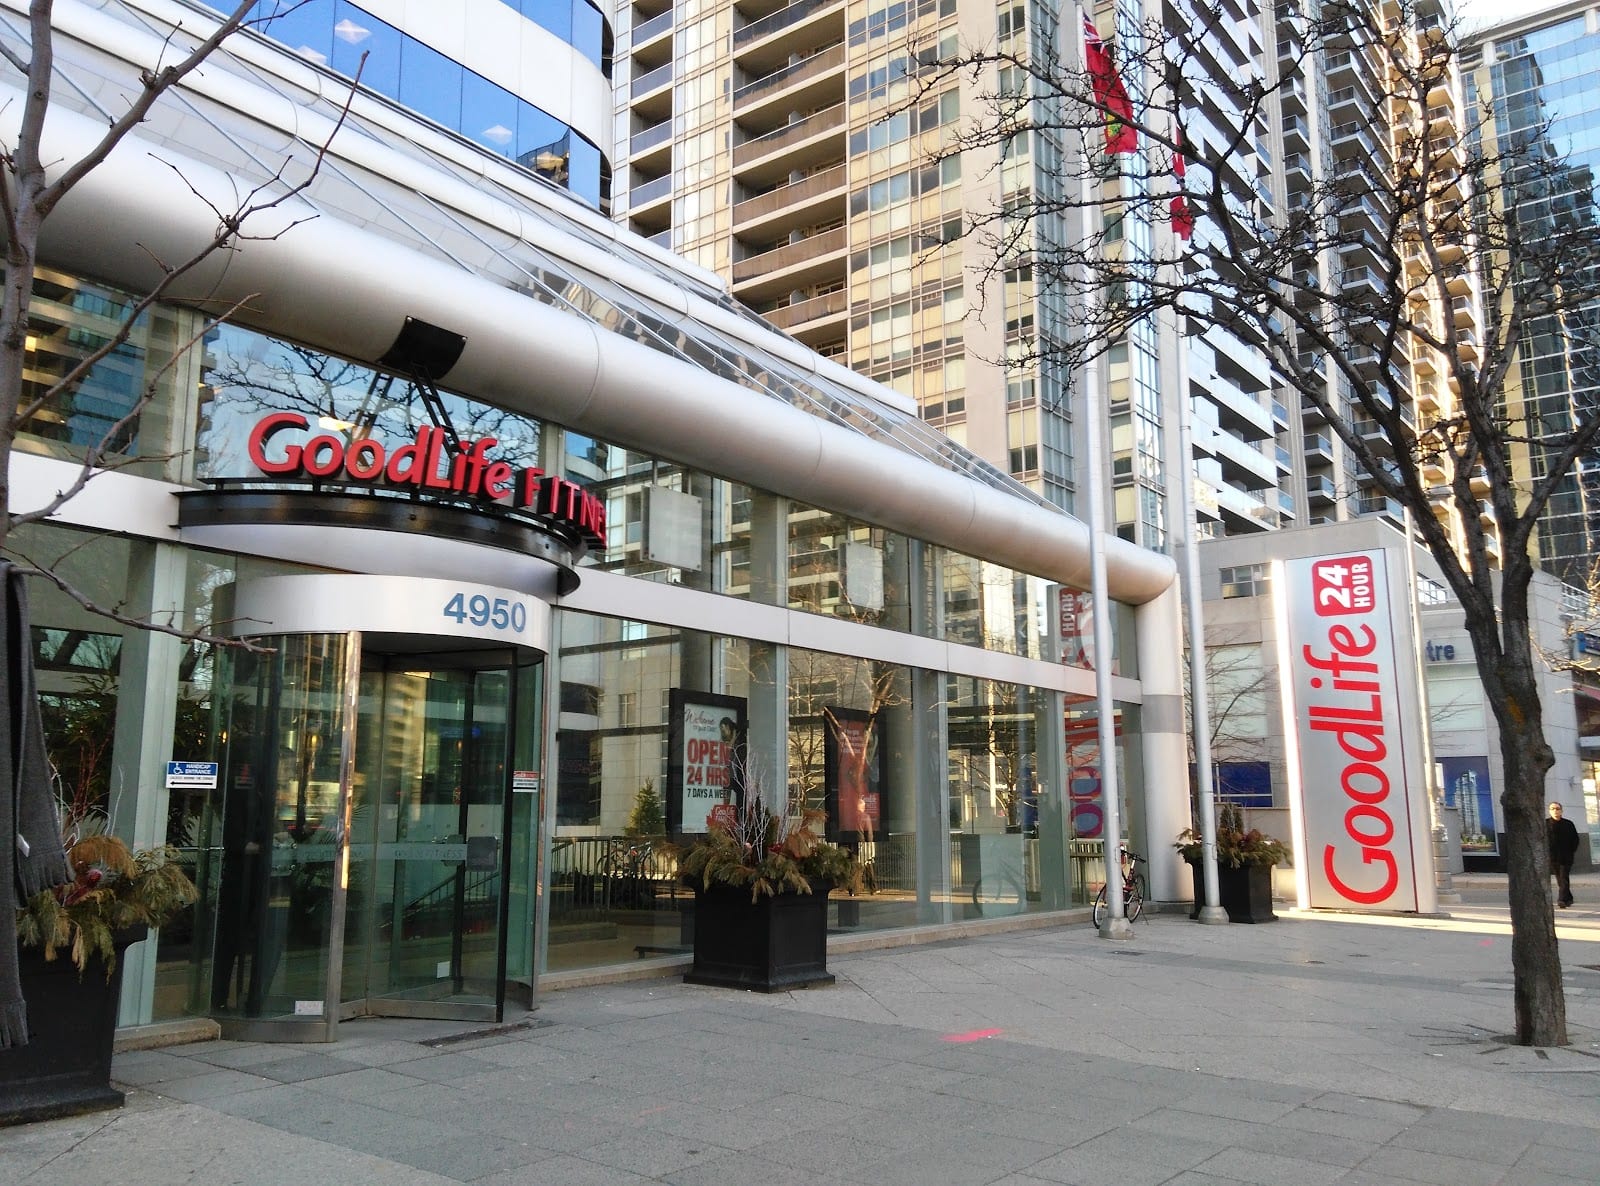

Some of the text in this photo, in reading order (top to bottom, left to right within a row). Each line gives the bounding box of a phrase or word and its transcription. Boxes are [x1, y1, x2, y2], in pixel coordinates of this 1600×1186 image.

[248, 412, 607, 547] GoodLife FITNE
[1318, 564, 1351, 608] 24
[1351, 562, 1371, 608] HOUR
[443, 592, 527, 633] 4950
[687, 738, 731, 765] OPEN
[1303, 623, 1398, 905] GoodLife
[687, 765, 730, 788] 24 HRS
[687, 788, 691, 798] 7
[692, 789, 708, 798] DAYS
[709, 789, 713, 798] A
